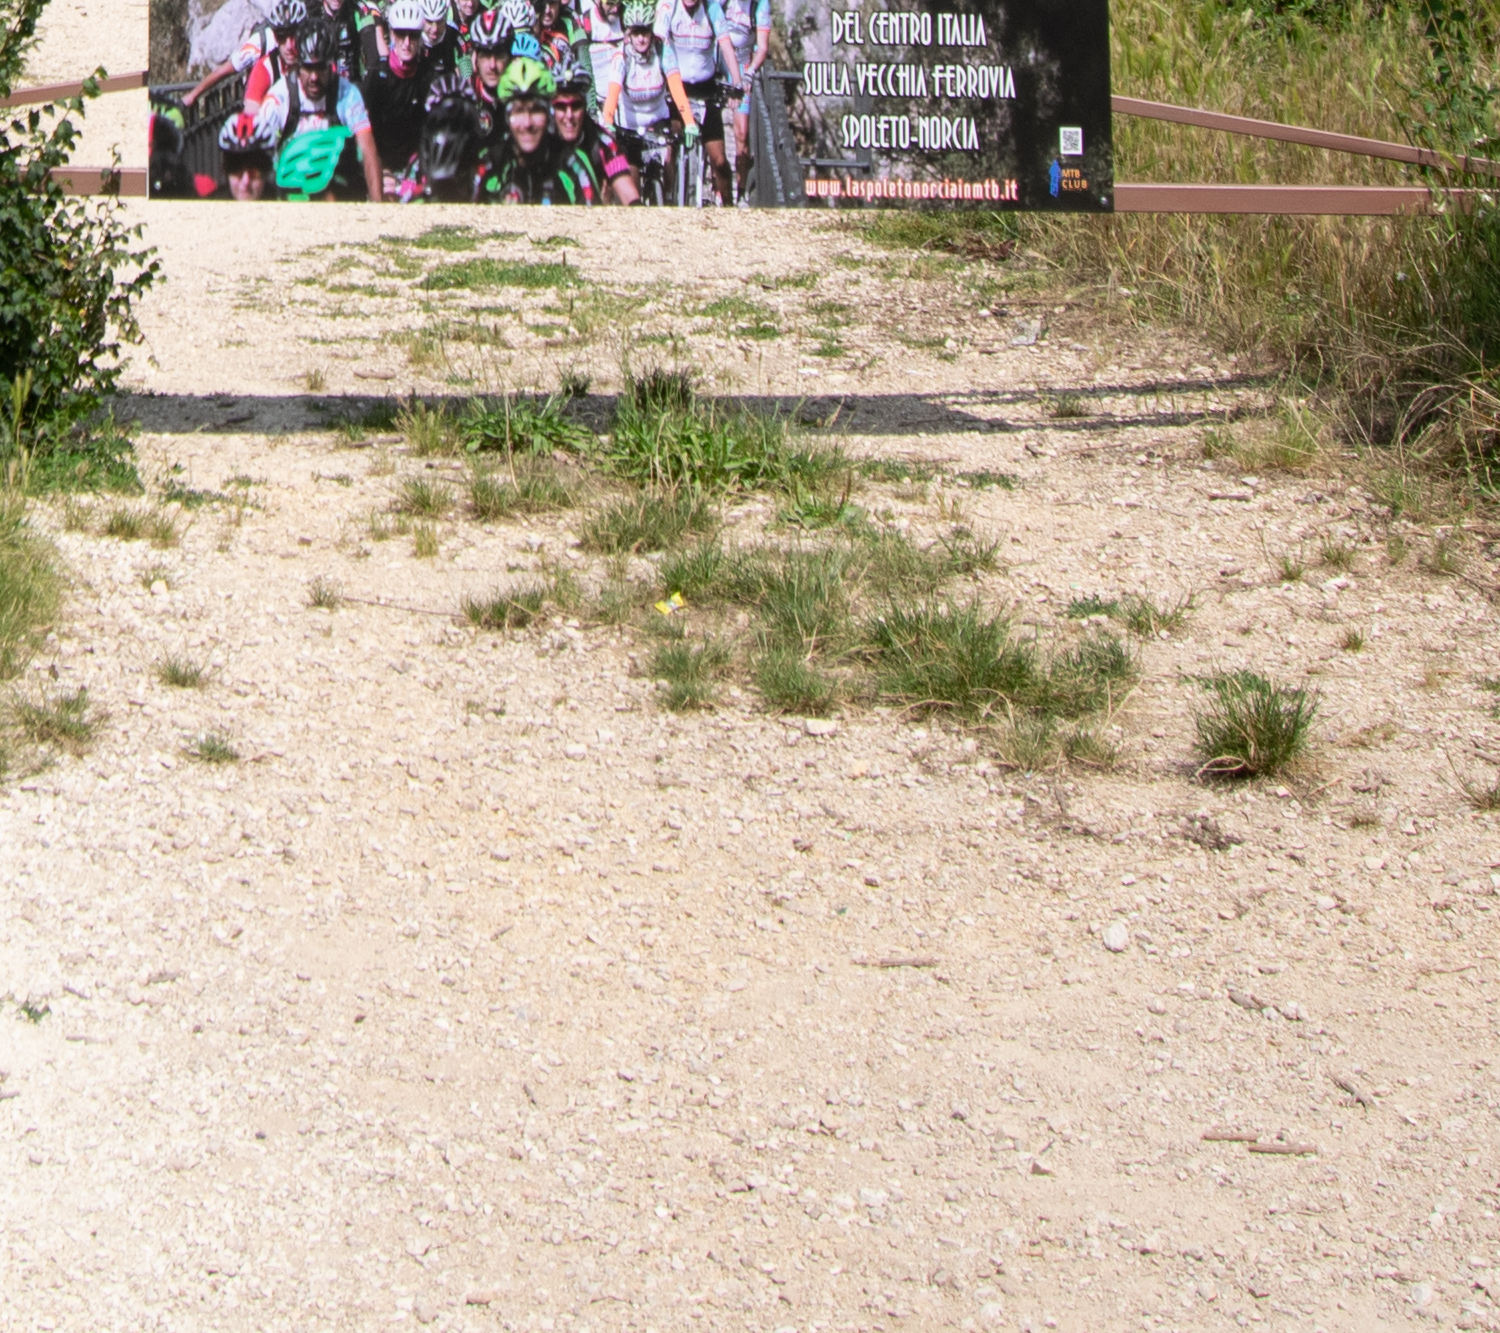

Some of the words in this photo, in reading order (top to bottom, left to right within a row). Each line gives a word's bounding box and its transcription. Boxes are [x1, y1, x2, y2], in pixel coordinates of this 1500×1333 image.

[832, 11, 864, 44] DEL
[869, 11, 932, 46] CENTRO
[938, 12, 987, 46] ITALIA
[804, 62, 851, 96] SULLA
[856, 63, 927, 97] VECCHIA
[932, 64, 1016, 99] FERROVIA
[842, 114, 979, 150] SPOLETO-NORCIA
[1062, 169, 1081, 178] MTB
[1062, 179, 1088, 189] CLUB
[805, 177, 1018, 201] www.laspoletonorciainmtb.it
